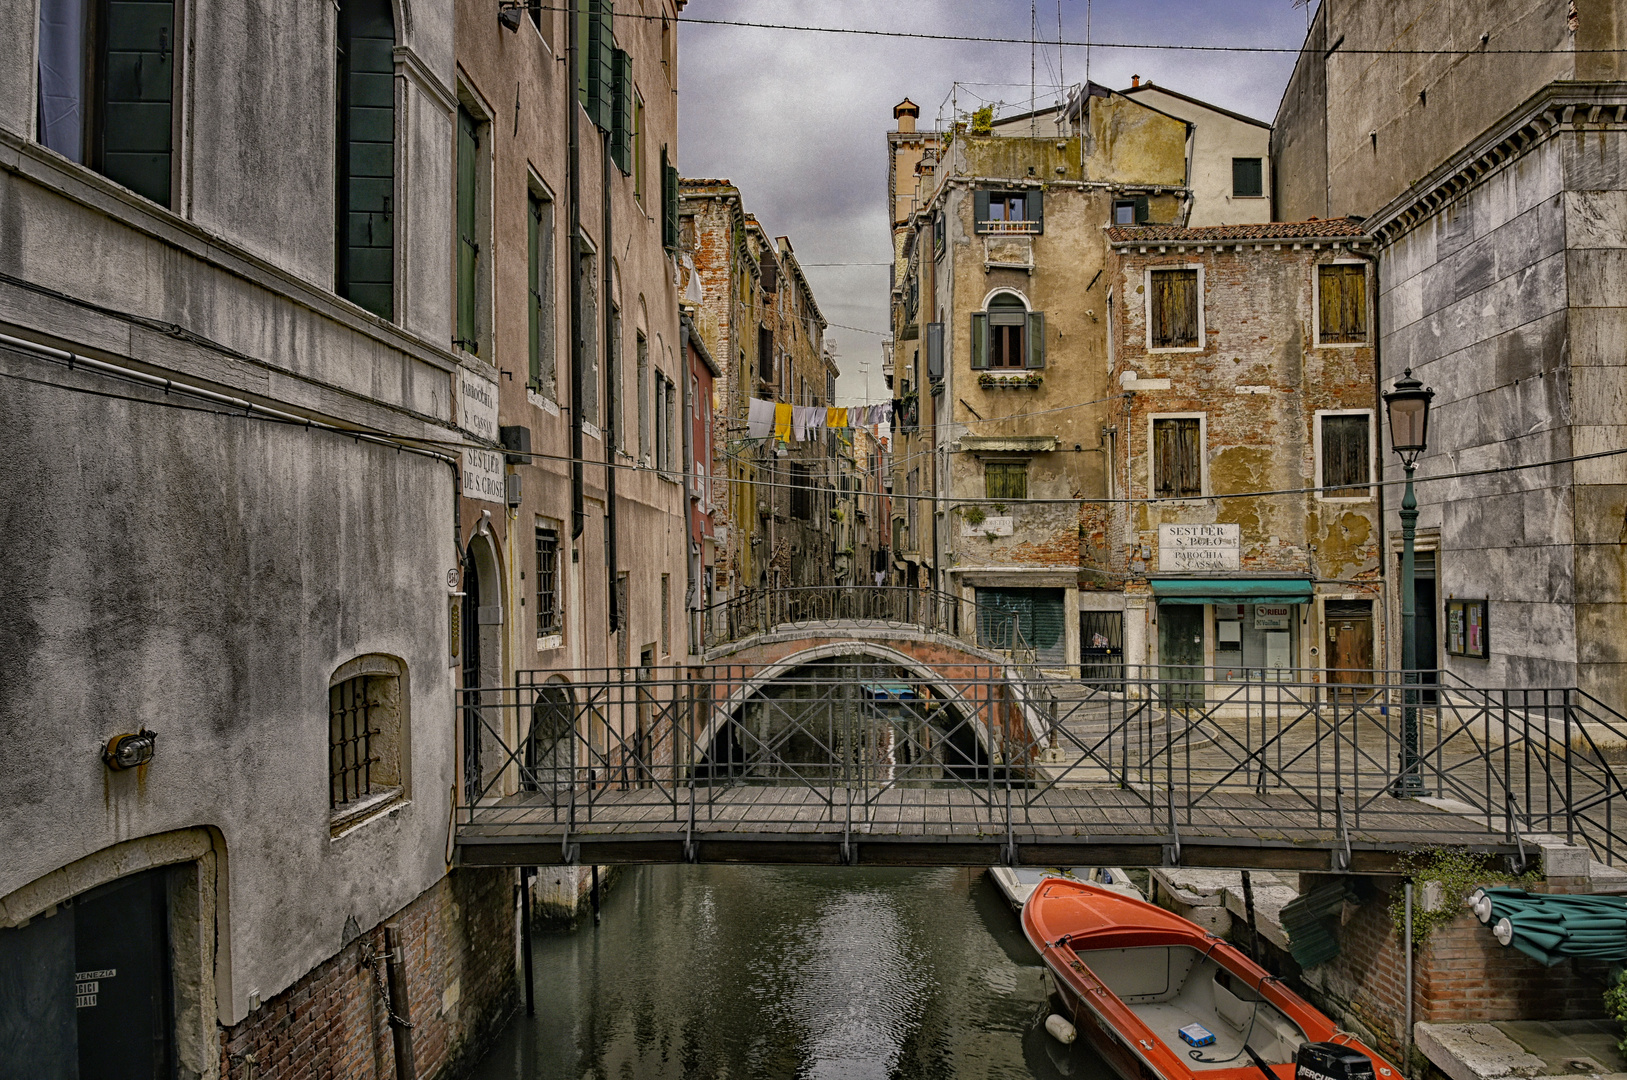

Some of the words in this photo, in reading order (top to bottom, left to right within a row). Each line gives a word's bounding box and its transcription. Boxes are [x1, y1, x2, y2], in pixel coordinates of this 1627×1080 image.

[468, 448, 500, 475] SESTIER
[463, 470, 474, 490] DE
[481, 477, 504, 498] CROSE
[1169, 527, 1224, 535] SESTIER
[1190, 537, 1222, 546] POLO
[1175, 551, 1223, 559] PAROCHIA
[1187, 561, 1224, 569] CASSAN
[1267, 608, 1288, 616] RIELLO
[75, 970, 114, 980] VENEZIA
